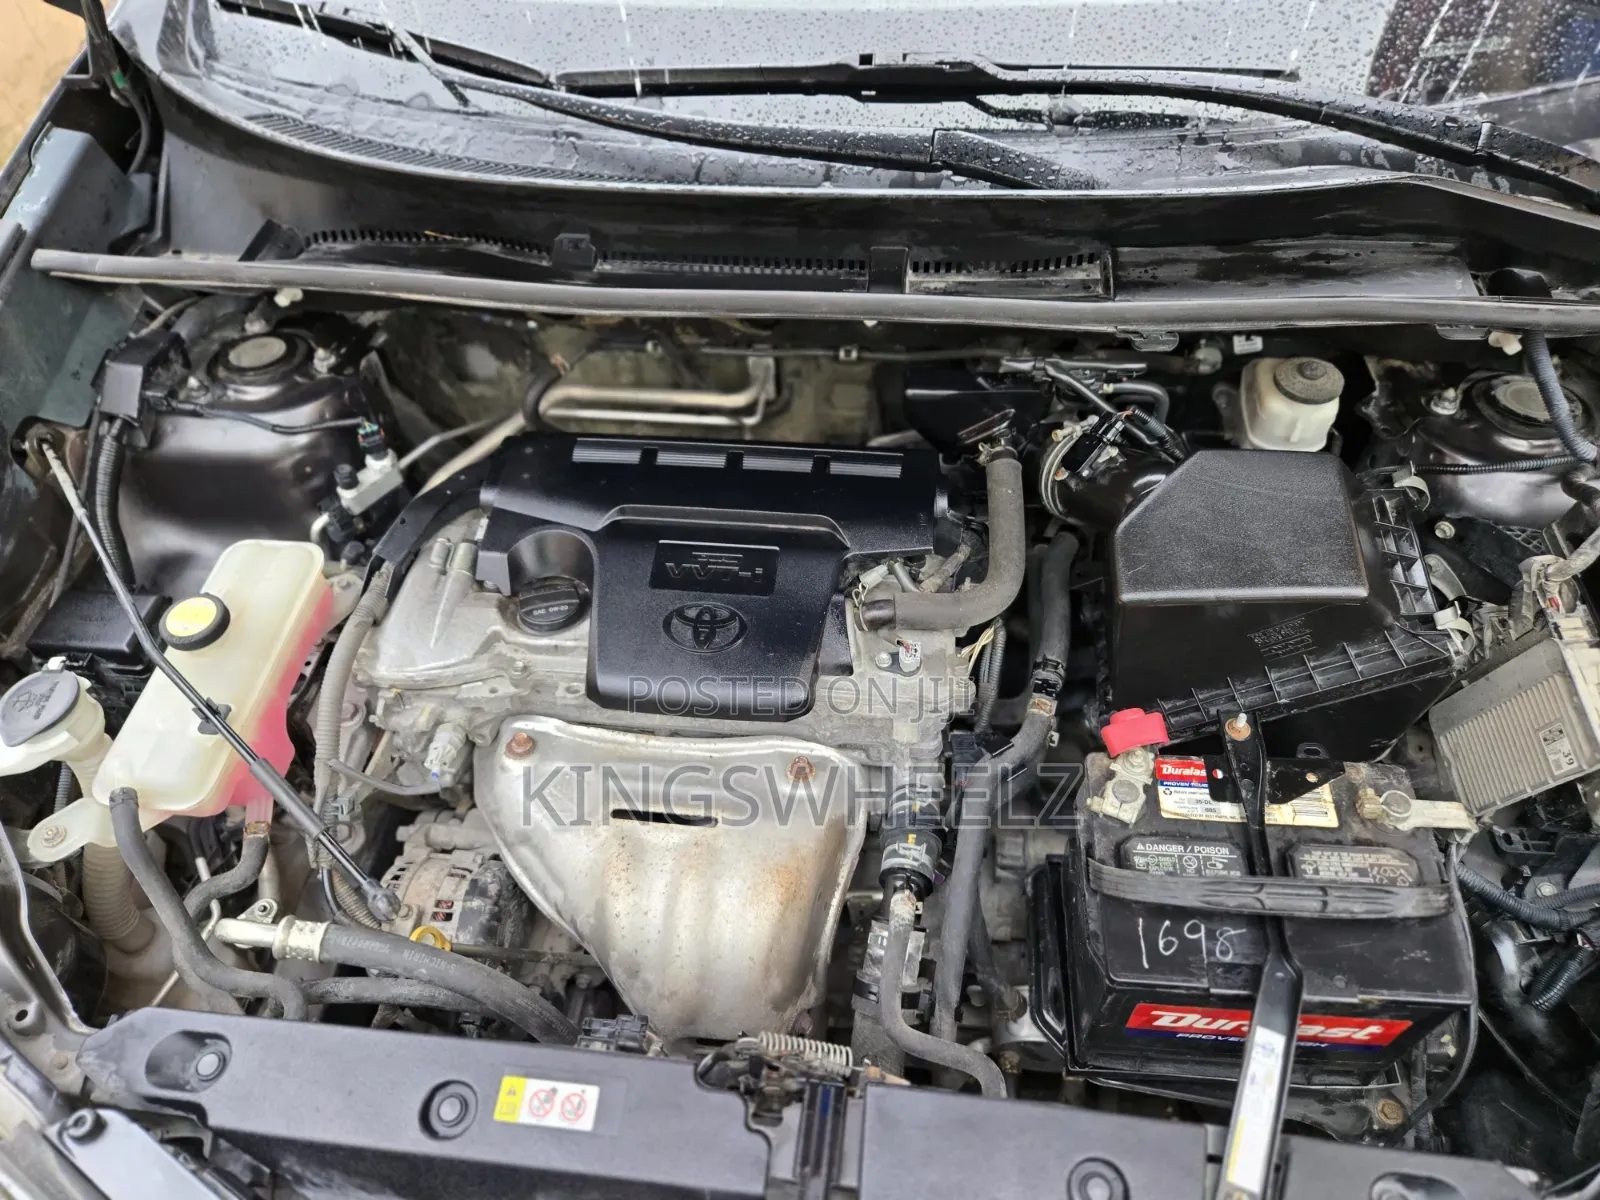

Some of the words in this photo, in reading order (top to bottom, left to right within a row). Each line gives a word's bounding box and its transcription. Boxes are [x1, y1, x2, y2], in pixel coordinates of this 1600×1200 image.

[532, 608, 546, 616] SAE
[1160, 764, 1207, 777] Duralas
[1146, 843, 1185, 853] DANGER
[1194, 846, 1229, 855] POISON
[1138, 917, 1247, 969] 1698
[1150, 1010, 1385, 1040] Durast
